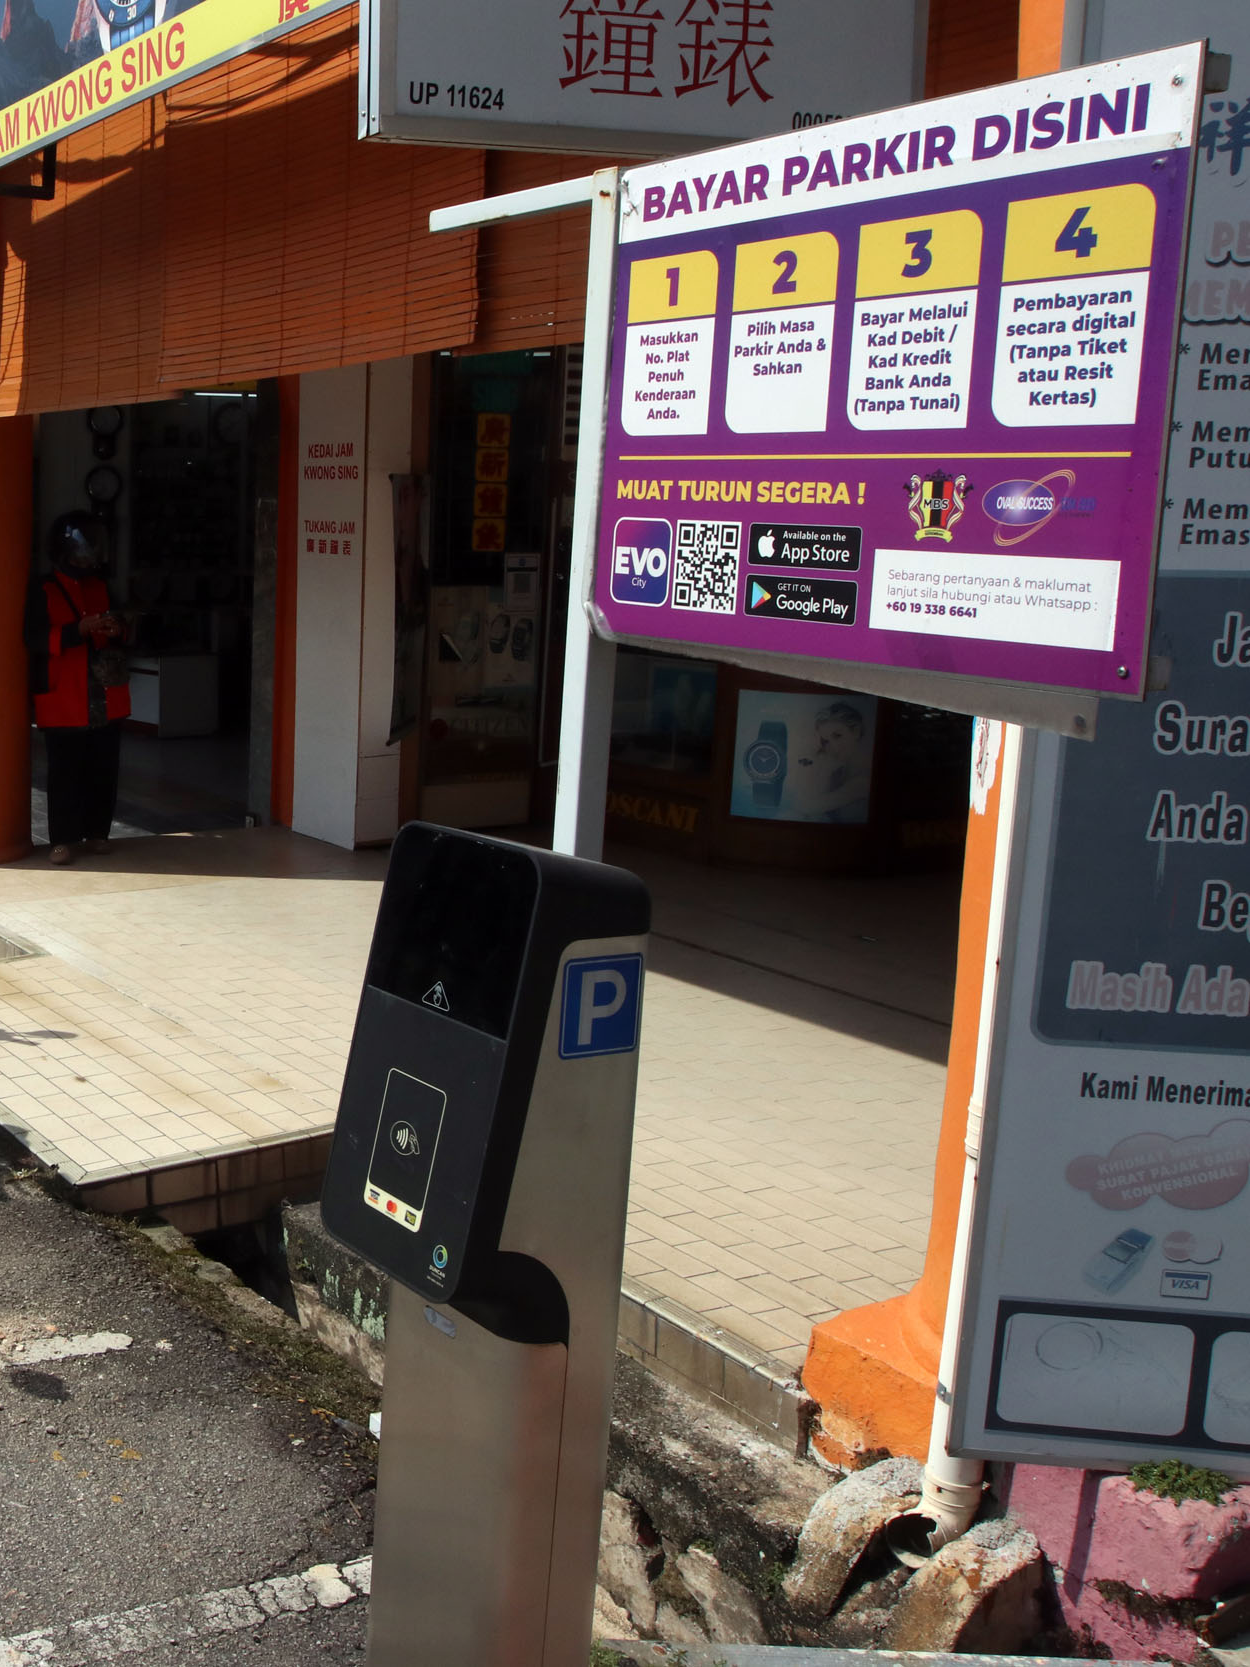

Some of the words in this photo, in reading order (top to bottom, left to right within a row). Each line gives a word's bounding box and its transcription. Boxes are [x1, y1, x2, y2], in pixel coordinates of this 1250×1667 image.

[559, 0, 775, 107] 鐘錶
[26, 61, 112, 141] KWONG
[121, 22, 185, 94] SING
[409, 82, 439, 107] UP
[446, 84, 504, 111] 11624
[642, 163, 770, 223] BAYAR
[782, 125, 956, 197] PARKIR
[971, 83, 1151, 161] DISINI
[1055, 206, 1097, 258] 4
[901, 229, 932, 278] 3
[772, 250, 797, 294] 2
[666, 267, 680, 307] 1
[1013, 289, 1132, 313] Pembayaran
[860, 310, 905, 329] Bayar
[909, 301, 968, 322] Melalui
[1006, 318, 1066, 337] secara
[1072, 311, 1136, 335] digital
[640, 331, 698, 346] Masukkan
[747, 323, 776, 336] Pilih
[780, 320, 814, 333] Masa
[868, 330, 897, 347] Kad
[901, 327, 945, 345] Debit
[646, 353, 663, 364] No.
[667, 351, 689, 362] Plat
[734, 343, 773, 358] Parkir
[777, 340, 812, 354] Anda
[817, 338, 826, 351] &
[1010, 342, 1072, 364] (Tanpa
[1077, 338, 1127, 356] Tiket
[753, 361, 802, 376] Sahkan
[868, 352, 897, 369] Kad
[902, 350, 951, 367] Kredit
[648, 370, 684, 383] Penuh
[865, 374, 904, 390] Bank
[909, 372, 951, 388] Anda
[1017, 367, 1059, 383] atau
[1065, 363, 1113, 380] Resit
[635, 389, 696, 402] Kenderaan
[854, 397, 905, 415] (Tanpa
[911, 394, 960, 413] Tunai)
[1029, 389, 1096, 407] Kertas)
[647, 408, 680, 419] Anda.
[308, 443, 333, 458] KEDAI
[336, 442, 354, 458] JAM
[304, 465, 336, 480] KWONG
[338, 465, 359, 480] SING
[617, 479, 673, 500] MUAT
[678, 480, 752, 502] TURUN
[756, 481, 851, 504] SEGERA
[923, 499, 949, 510] MBS
[997, 497, 1018, 510] OVAL
[1020, 497, 1053, 511] SUCCESS
[305, 520, 337, 534] TUKANG
[338, 521, 356, 535] JAM
[783, 530, 818, 541] Available
[833, 533, 846, 542] the
[615, 546, 667, 578] EVO
[781, 543, 811, 563] App
[813, 545, 850, 563] Store
[632, 577, 647, 589] City
[777, 583, 790, 591] GET
[792, 584, 799, 592] IT
[800, 584, 811, 593] ON
[888, 569, 940, 585] Sebarang
[944, 573, 1010, 589] pertanyaan
[1013, 577, 1021, 588] &
[1025, 578, 1091, 593] maklumat
[776, 595, 821, 616] Google
[823, 598, 848, 618] Play
[887, 585, 917, 599] lanjut
[920, 588, 938, 599] sila
[942, 589, 991, 604] hubungi
[994, 594, 1021, 605] atau
[1024, 595, 1091, 611] Whatsapp
[886, 602, 907, 612] +60
[910, 602, 921, 613] 19
[924, 604, 946, 615] 338
[949, 605, 977, 618] 6641
[1150, 793, 1246, 842] Anda
[1069, 961, 1171, 1012] Masih
[577, 969, 627, 1046] P
[1080, 1071, 1138, 1100] Kami
[1146, 1075, 1250, 1107] Menerima
[1096, 1151, 1164, 1175] KHIDMAT
[1095, 1170, 1146, 1190] SURAT
[1150, 1159, 1199, 1179] PAJAK
[1120, 1166, 1239, 1200] KONVENSIONAL
[1172, 1279, 1199, 1290] VISA
